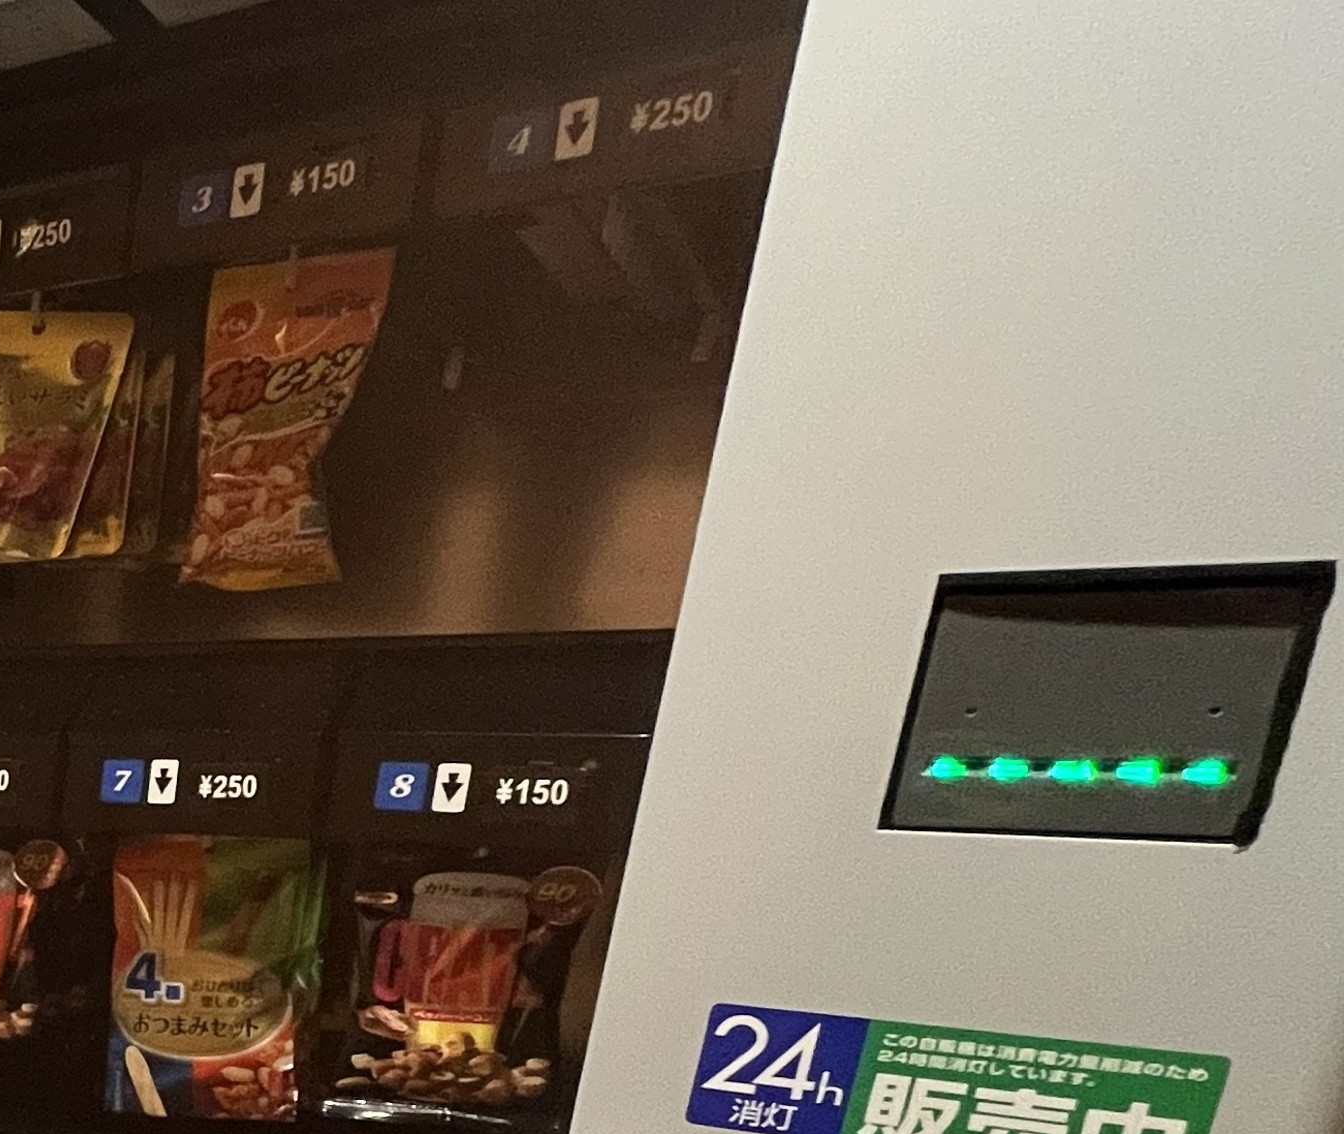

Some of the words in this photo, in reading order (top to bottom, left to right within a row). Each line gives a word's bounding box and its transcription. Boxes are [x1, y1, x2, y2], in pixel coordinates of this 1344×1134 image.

[506, 126, 531, 157] 4
[629, 91, 714, 134] ¥250
[190, 186, 212, 214] 3
[288, 159, 356, 198] ¥150
[112, 770, 132, 792] 7
[198, 774, 257, 800] ¥250
[389, 773, 415, 798] 8
[495, 779, 569, 806] ¥150
[132, 1013, 259, 1038] おつまみセット
[700, 1013, 844, 1107] 24h
[876, 1050, 1096, 1088] 24時間消灯しています。
[727, 1097, 798, 1132] 消灯
